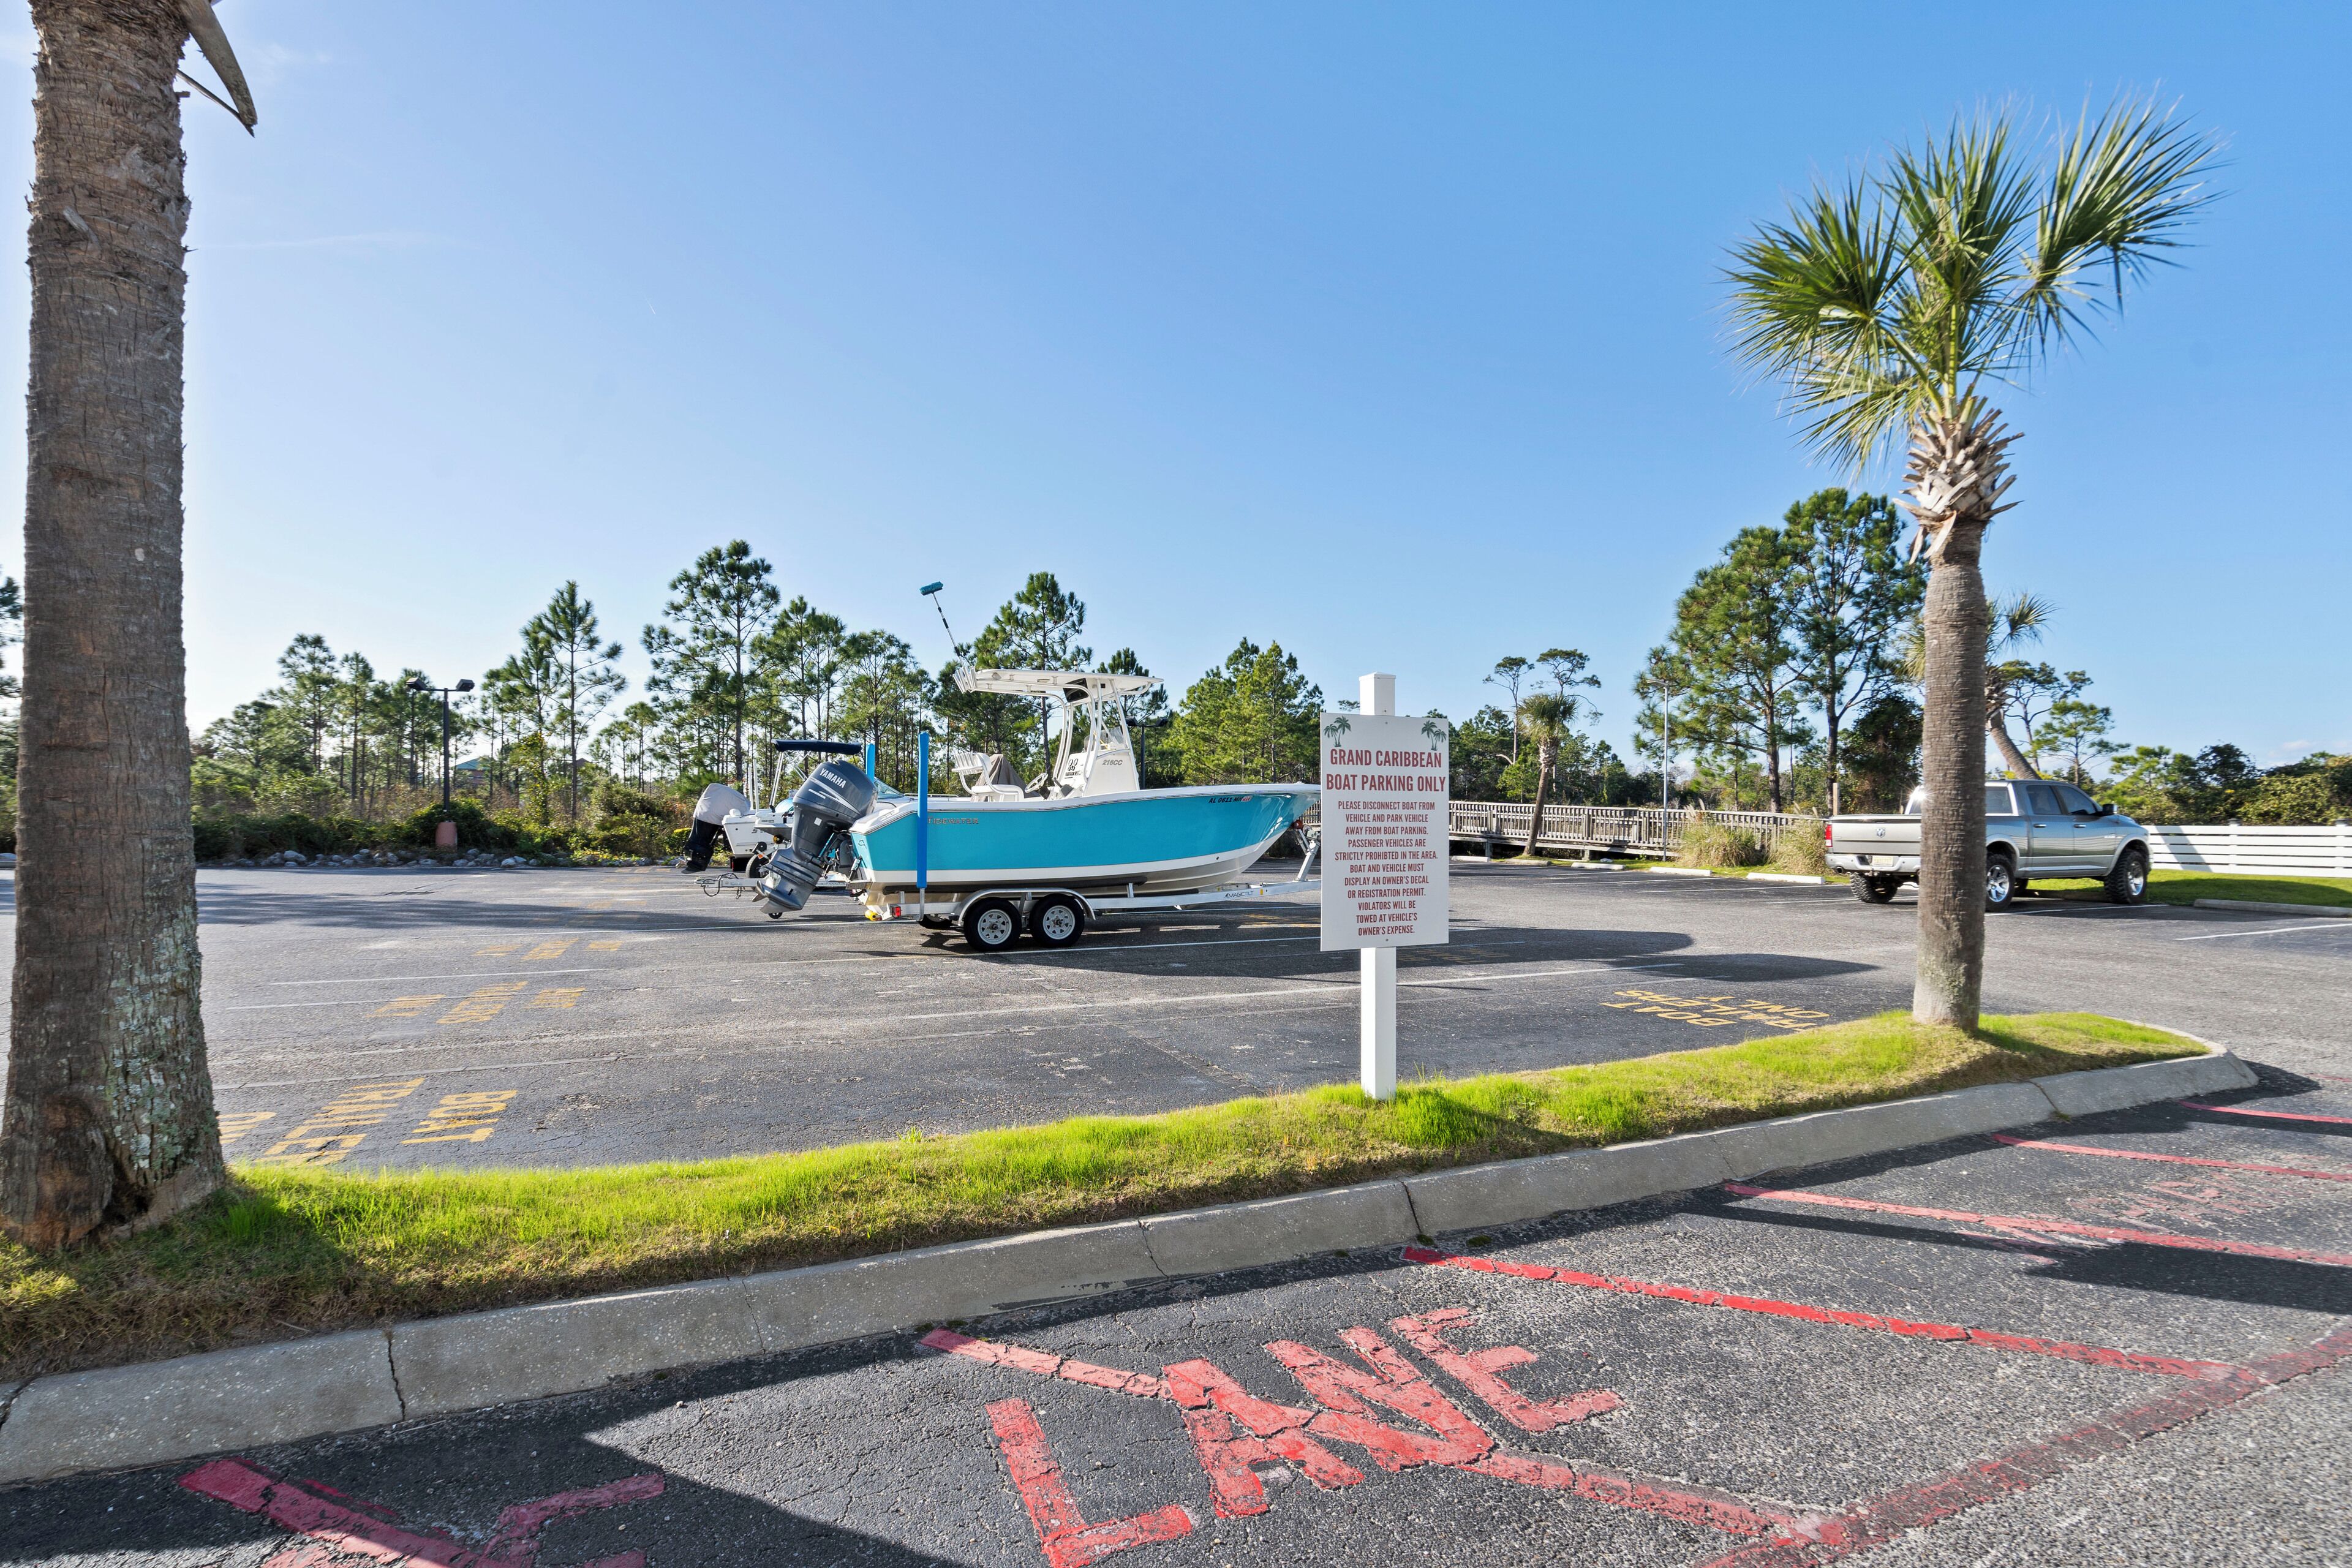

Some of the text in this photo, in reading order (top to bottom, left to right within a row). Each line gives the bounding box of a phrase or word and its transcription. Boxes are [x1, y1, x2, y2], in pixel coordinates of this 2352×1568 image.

[1330, 749, 1442, 767] GRAND CARIBBEAN
[820, 767, 846, 788] YAMAHA
[1326, 774, 1446, 791] BOAT PARKING ONLY
[1338, 801, 1435, 810] PLEASE DISCONNECT BOAT FROM
[1346, 813, 1370, 822] VEHICLE
[1346, 826, 1363, 835] AWAY
[1348, 839, 1384, 848] PASSENGER
[1415, 839, 1426, 847] ARE
[1335, 852, 1363, 861] STRICTLY
[1366, 851, 1398, 860] PROHIBTED
[1350, 864, 1366, 873] BOAT
[1382, 864, 1406, 872] VEHICLE
[1345, 875, 1429, 886] DISPLAY AN OWNER'S DECAL
[1348, 888, 1426, 899] OR REGISTRATION PERMIT.
[1358, 902, 1391, 910] VIOLATORS
[1356, 913, 1417, 923] TOWED AT VEHICLE'S
[1359, 925, 1415, 936] OWNER'S EXPENSE.
[1695, 997, 1830, 1019] ONLY
[1599, 1001, 1737, 1027] BOAT
[251, 1078, 426, 1166] TRAILER
[401, 1090, 518, 1144] BOAT
[985, 1308, 1626, 1568] LANE
